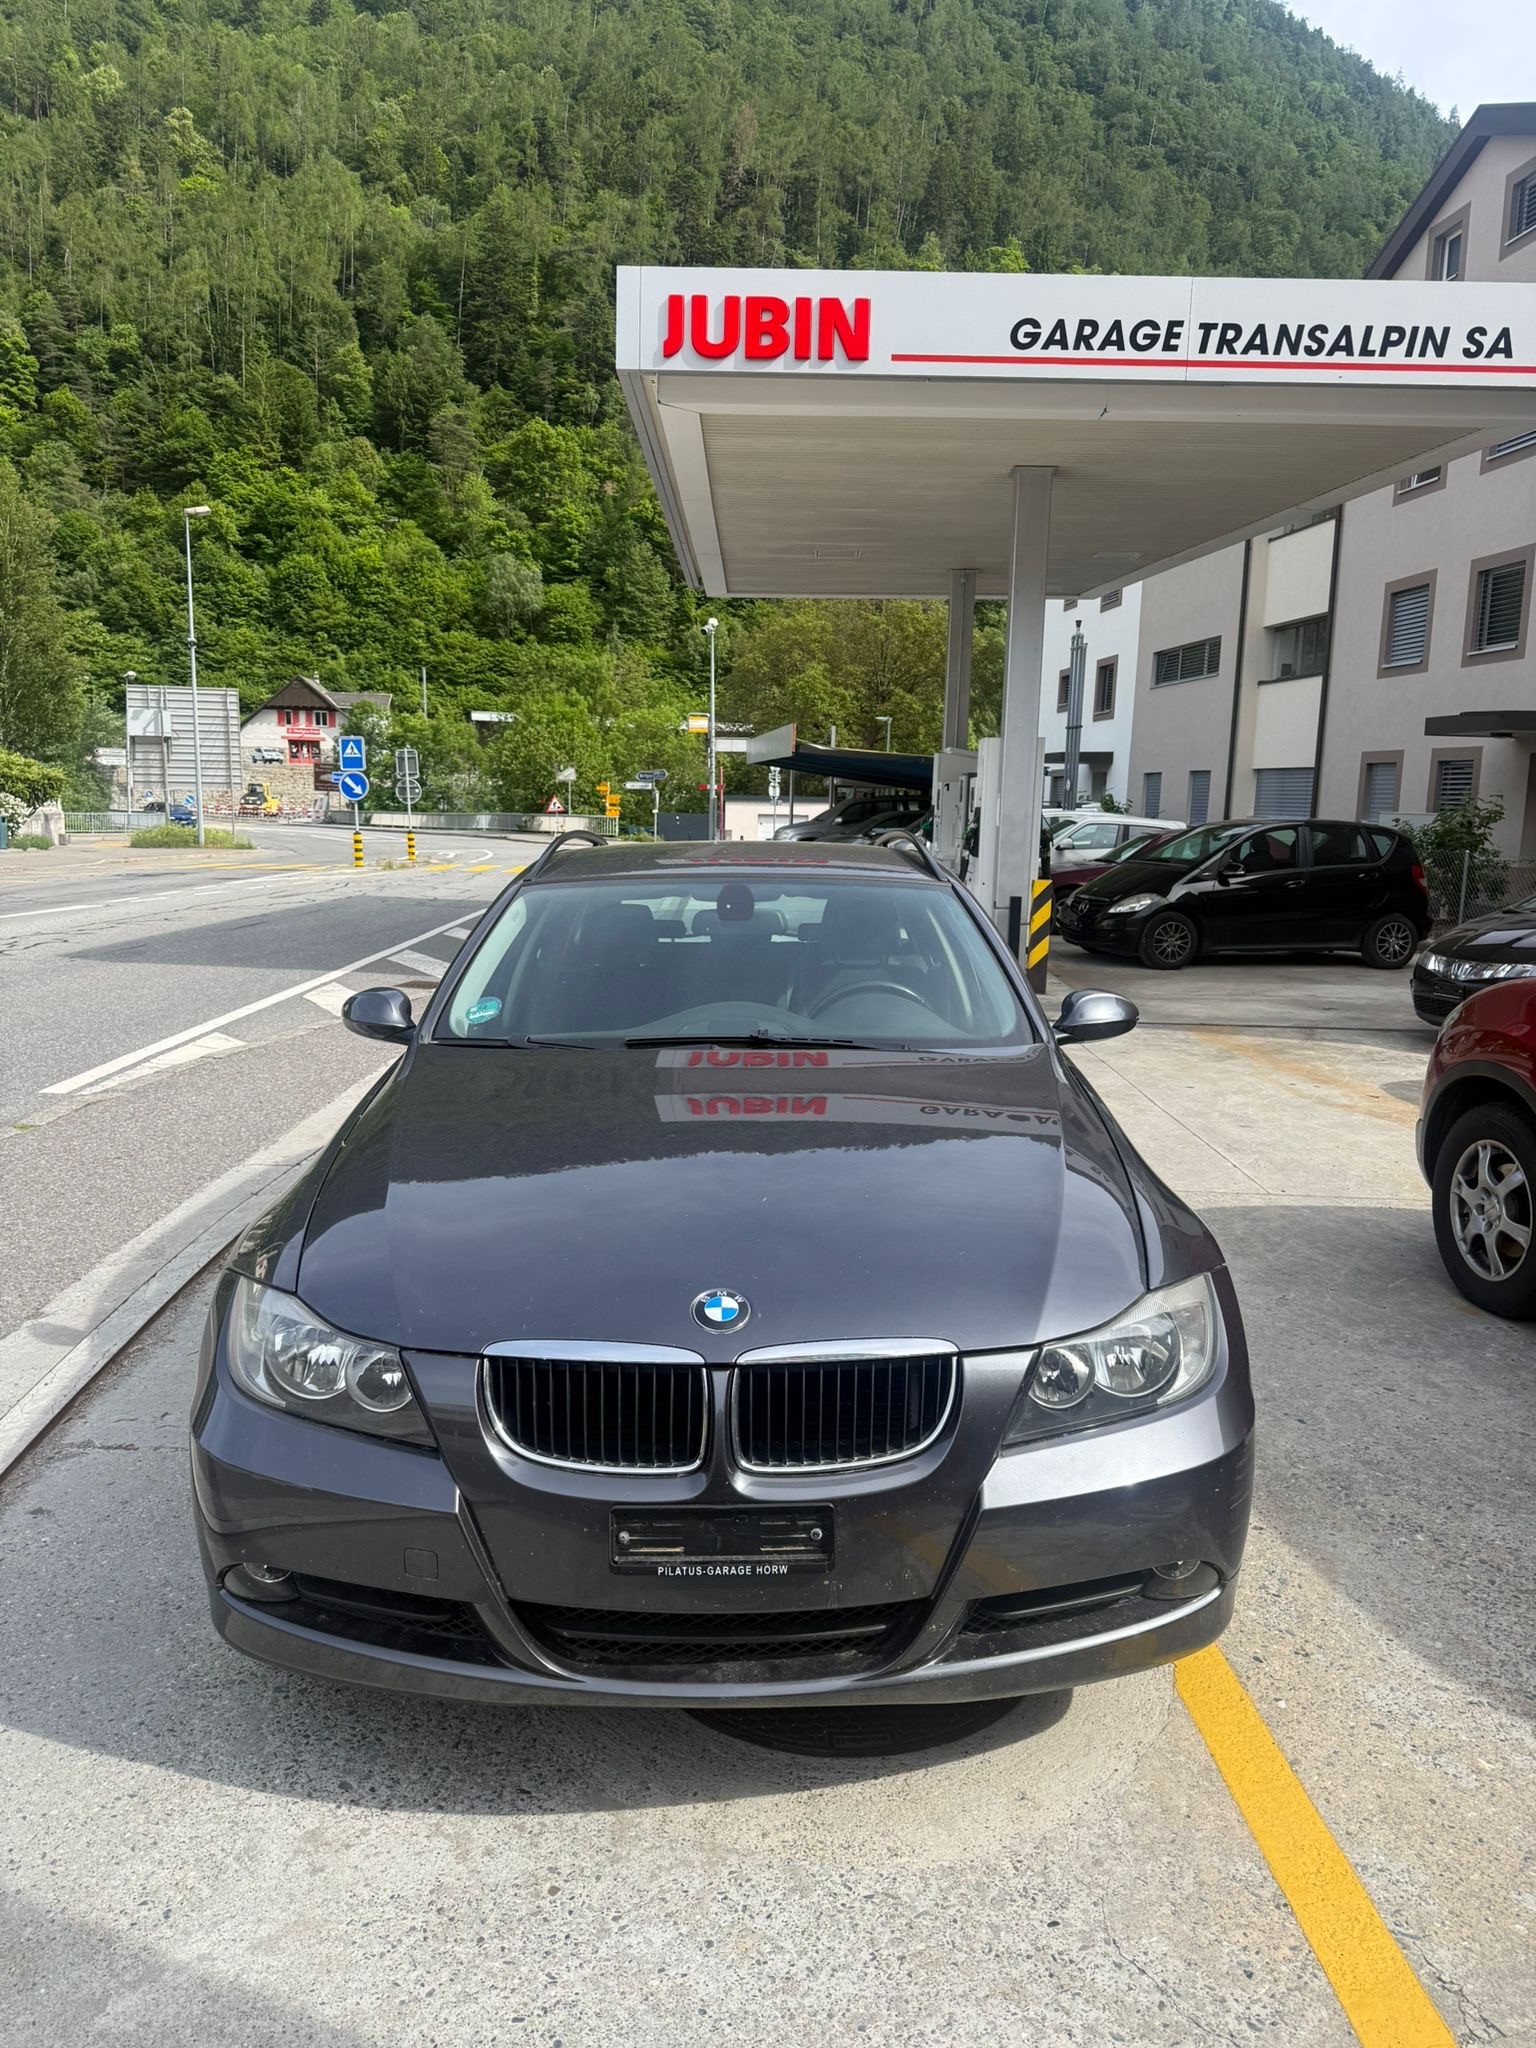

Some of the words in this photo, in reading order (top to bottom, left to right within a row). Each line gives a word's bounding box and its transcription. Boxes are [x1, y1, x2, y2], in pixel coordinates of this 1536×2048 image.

[663, 294, 871, 361] JUBIN
[1010, 317, 1185, 352] GARAGE
[1198, 322, 1451, 358] TRANSALPIN
[1462, 326, 1514, 359] SA
[700, 1290, 745, 1303] BMW
[657, 1565, 752, 1576] PILATUS-GARAGE
[756, 1564, 789, 1575] HORW
